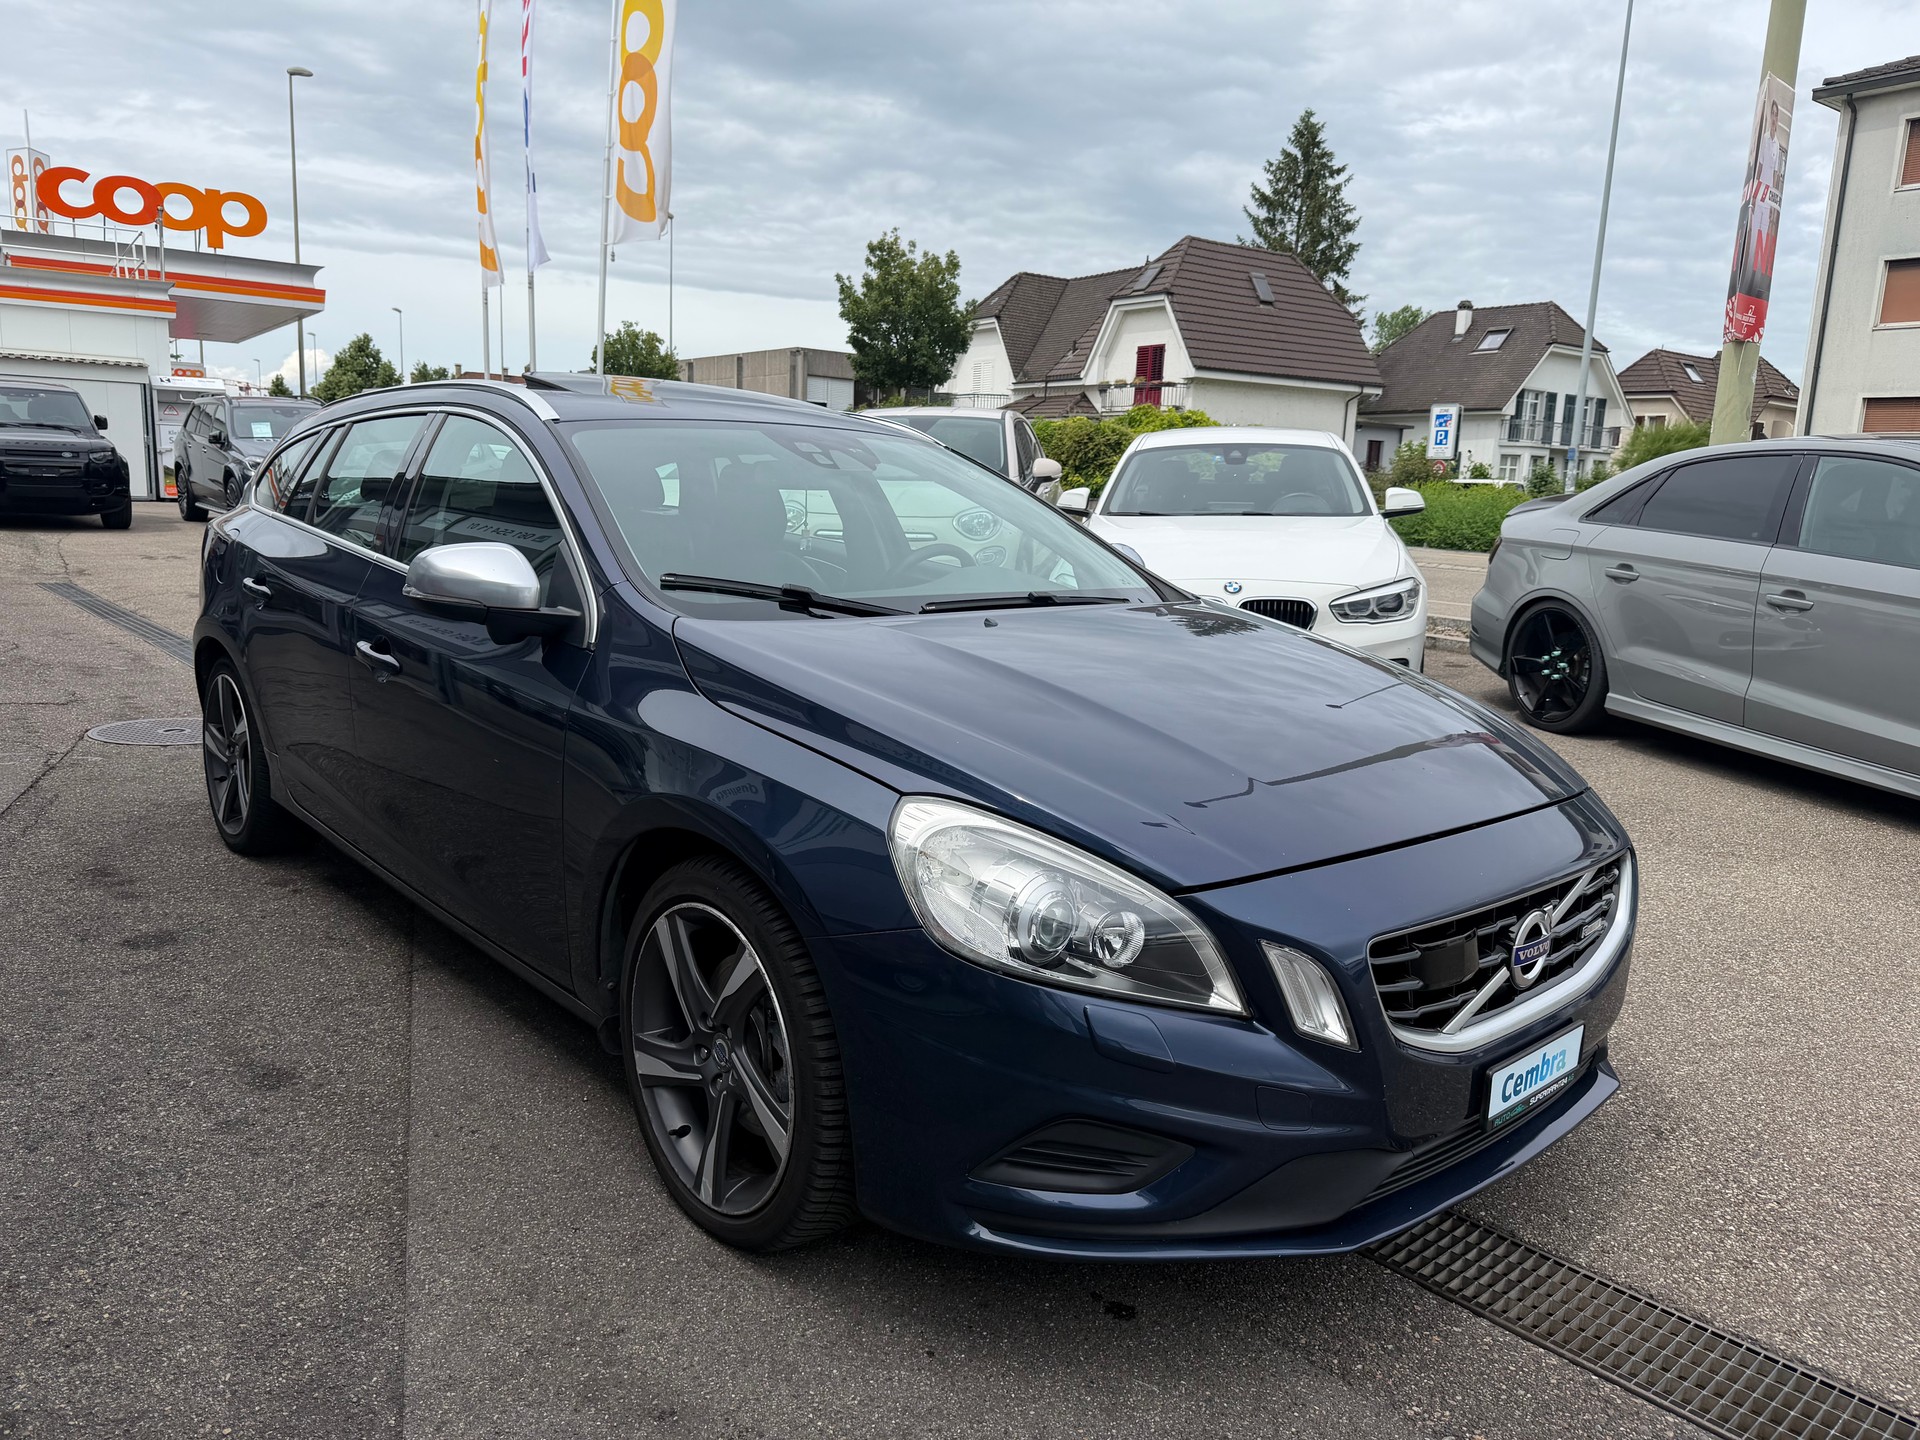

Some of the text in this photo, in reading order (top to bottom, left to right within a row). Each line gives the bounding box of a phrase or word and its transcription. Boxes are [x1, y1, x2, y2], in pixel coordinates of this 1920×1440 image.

[11, 154, 29, 232] oop
[36, 166, 268, 249] coop
[1501, 1049, 1567, 1103] Cembra
